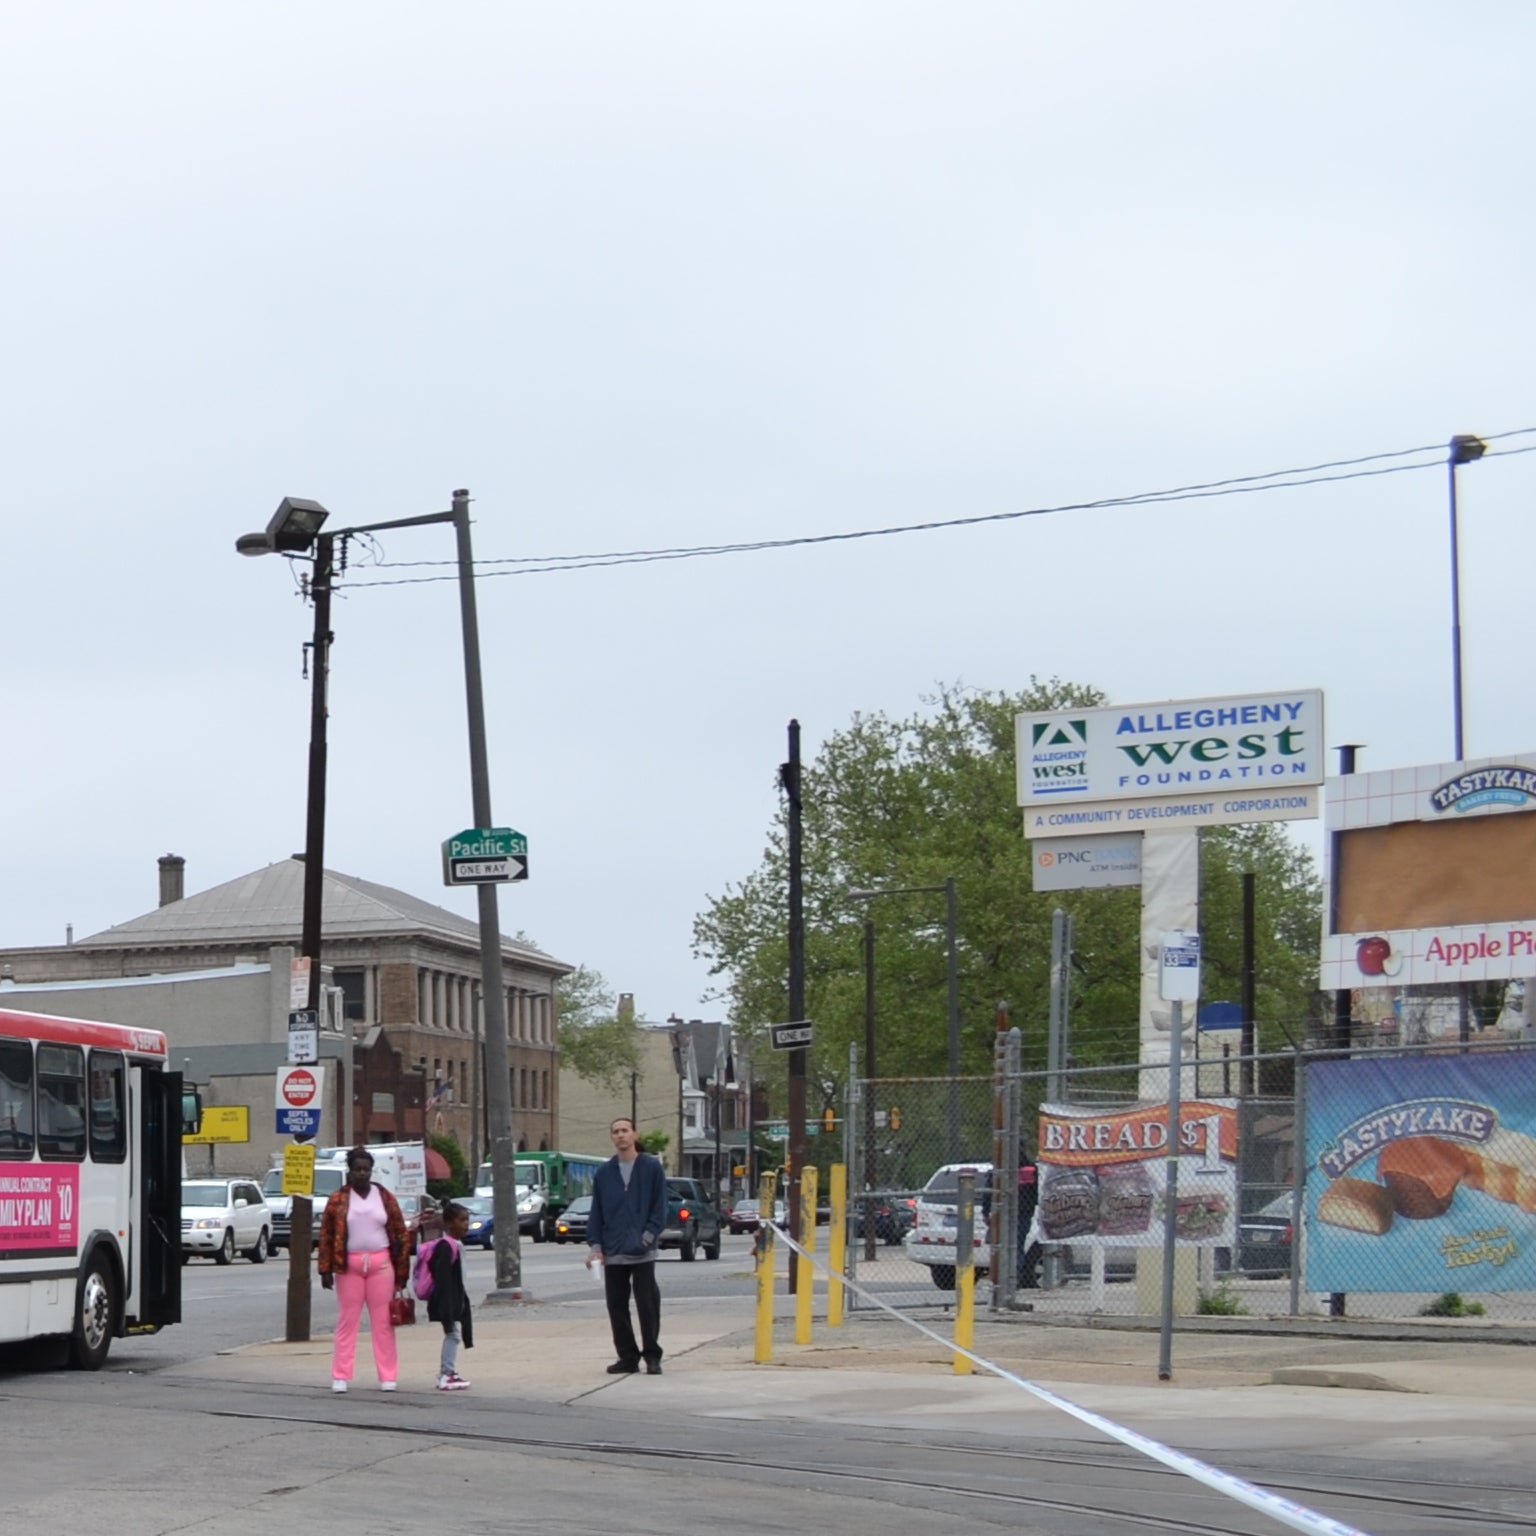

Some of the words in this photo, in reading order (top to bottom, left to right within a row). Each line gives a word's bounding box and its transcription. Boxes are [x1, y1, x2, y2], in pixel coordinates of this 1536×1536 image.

[1116, 701, 1304, 735] ALLEGHENY
[1116, 725, 1305, 767] west
[1033, 750, 1087, 762] ALLEGHENY
[1033, 760, 1086, 779] west
[1119, 762, 1306, 787] FOUNDATION
[1032, 779, 1088, 787] FOUNDATION
[1035, 816, 1043, 826] A
[1049, 810, 1122, 826] COMMUNITY
[1128, 803, 1214, 820] DEVELOPMENT
[1224, 797, 1308, 813] CORPORATION
[451, 838, 505, 856] Pacific
[510, 839, 526, 853] St
[1057, 851, 1092, 864] PNC
[460, 865, 481, 875] ONE
[484, 864, 506, 873] WAY
[1111, 863, 1138, 871] Inside
[1425, 933, 1501, 966] Apple
[1507, 931, 1536, 956] Pi
[296, 1013, 308, 1023] NO
[138, 1034, 161, 1051] SEPTA
[779, 1031, 797, 1041] ONE
[289, 1124, 307, 1132] ONLY
[1045, 1122, 1168, 1150] BREAD
[1181, 1113, 1227, 1174] $1
[1324, 1107, 1487, 1171] TASTYKAKE
[21, 1177, 52, 1192] CONTRACT
[25, 1199, 52, 1226] PLAN
[1441, 1237, 1518, 1268] Tasty!
